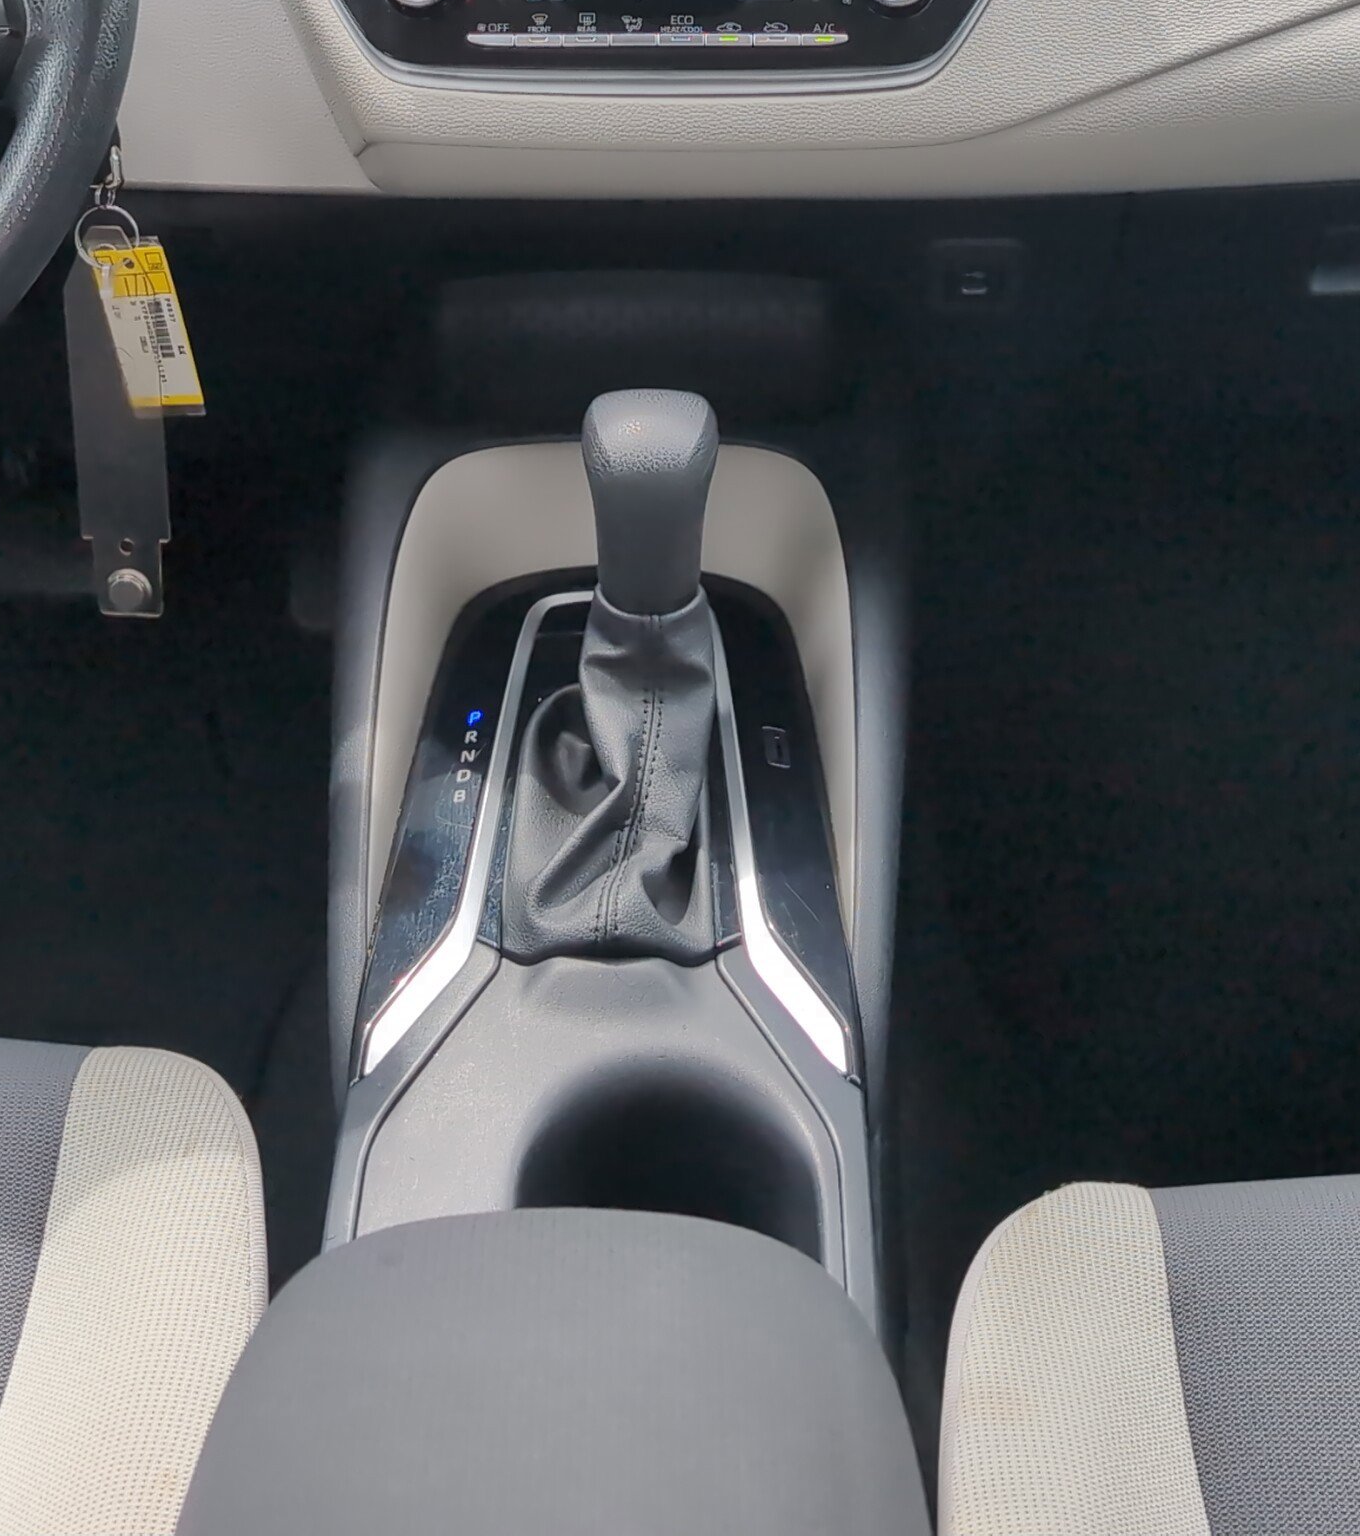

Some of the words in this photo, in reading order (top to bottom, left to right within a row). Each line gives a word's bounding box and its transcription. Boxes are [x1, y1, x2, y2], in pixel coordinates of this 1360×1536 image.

[487, 22, 510, 32] OFF
[670, 15, 694, 25] ECO
[813, 23, 835, 33] A/C
[467, 710, 482, 726] P
[464, 729, 478, 744] R
[460, 749, 476, 763] N
[456, 769, 472, 783] D
[453, 789, 466, 804] B
